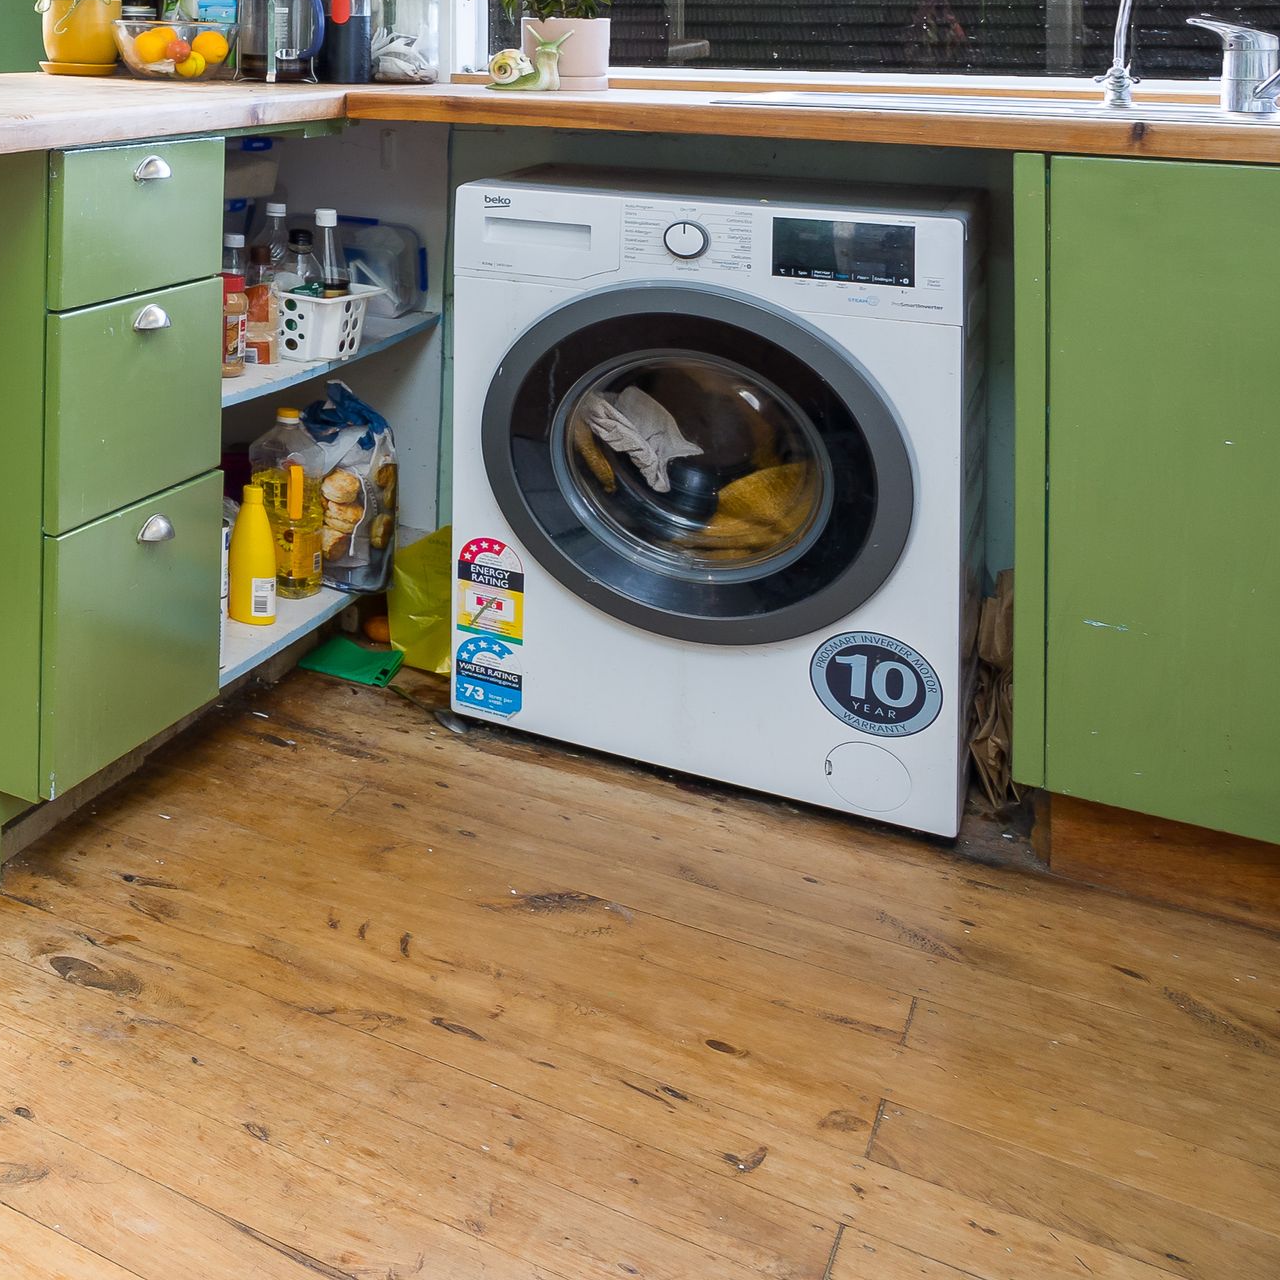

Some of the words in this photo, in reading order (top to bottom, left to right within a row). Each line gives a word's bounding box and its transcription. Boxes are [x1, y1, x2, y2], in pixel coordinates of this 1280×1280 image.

[484, 195, 511, 205] beko
[470, 564, 510, 579] ENERGY
[472, 574, 508, 588] RATING
[459, 661, 486, 674] WATER
[488, 669, 518, 682] RATING
[815, 635, 858, 669] PROSMART
[861, 635, 912, 659] INVERTER
[912, 658, 937, 694] MOTOR
[835, 654, 918, 708] 10
[852, 701, 896, 718] YEAR
[843, 711, 908, 733] WARRANTY
